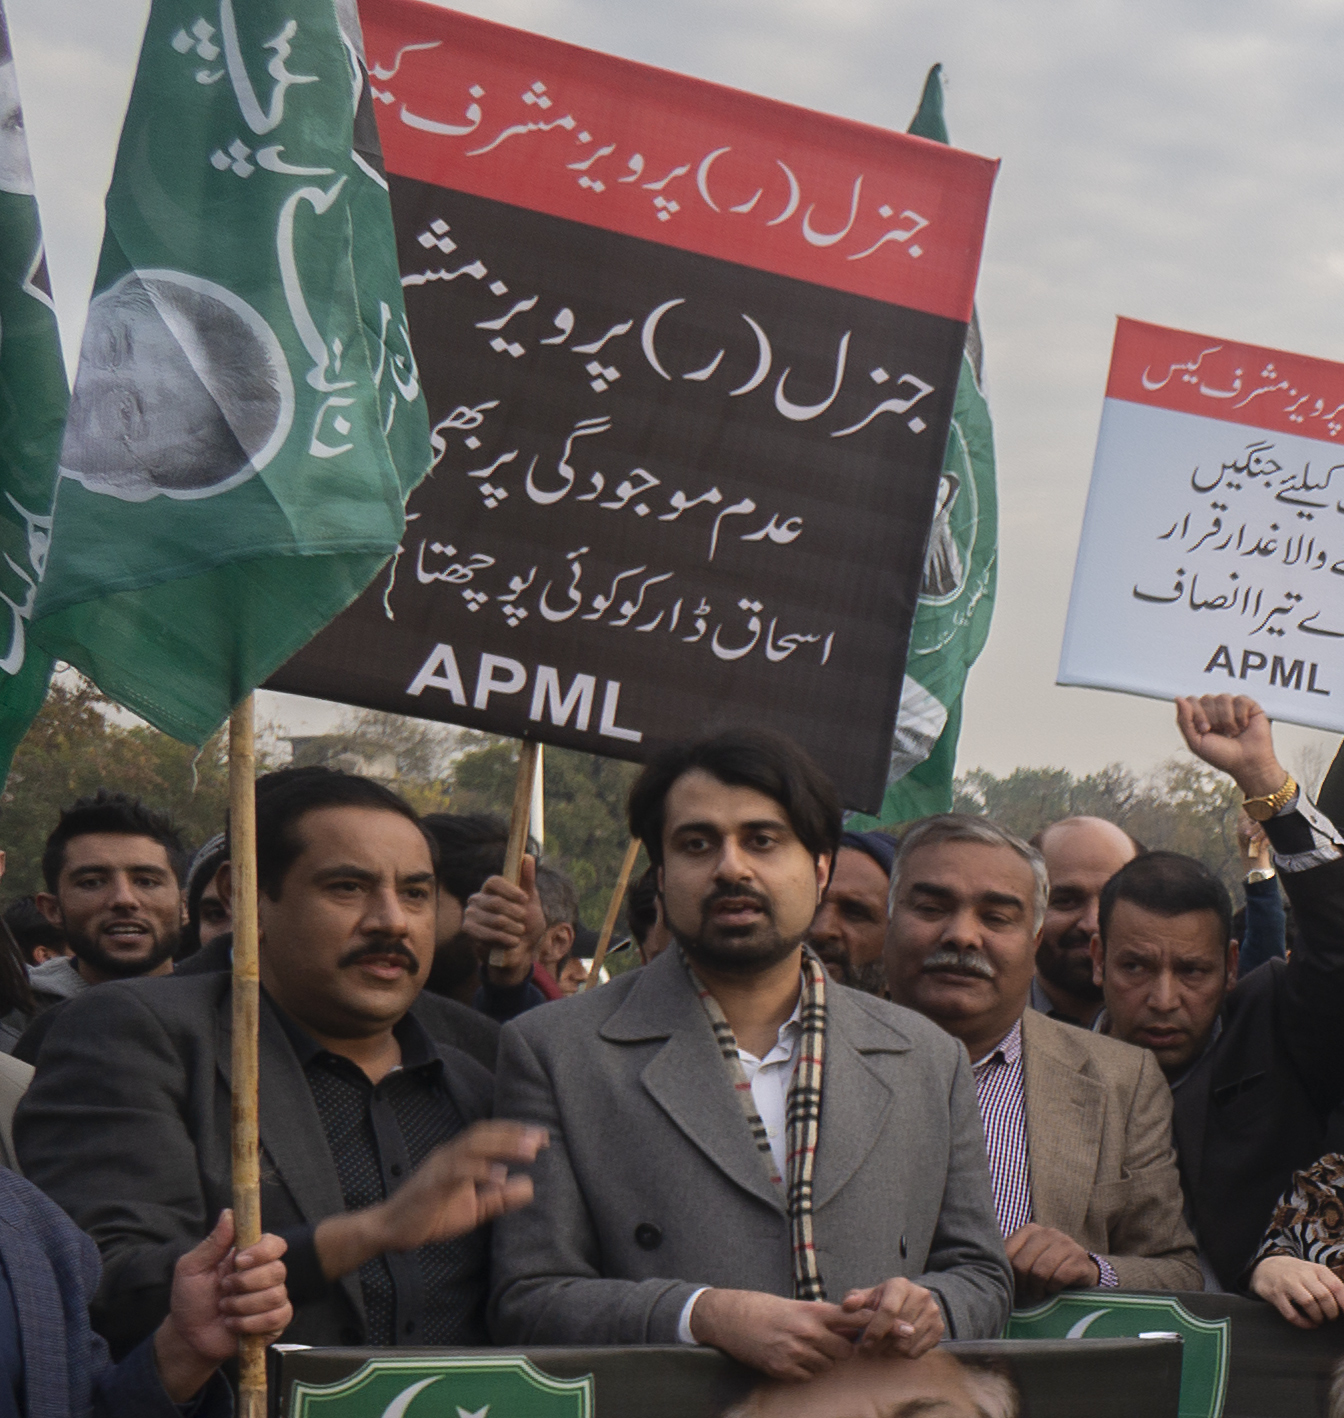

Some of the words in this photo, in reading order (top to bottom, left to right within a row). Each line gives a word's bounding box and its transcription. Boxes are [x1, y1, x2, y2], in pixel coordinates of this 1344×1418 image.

[367, 40, 443, 105] کی
[400, 80, 576, 157] مشرف
[567, 131, 691, 222] پرویز
[475, 278, 634, 393] پرویز
[1141, 345, 1224, 391] کیس
[1200, 362, 1290, 409] مشرف
[468, 449, 519, 509] پر
[525, 416, 723, 517] موجودگی
[708, 497, 804, 562] عدم
[1157, 501, 1229, 553] قرار
[1212, 522, 1279, 557] غدار
[1282, 533, 1328, 571] والا
[635, 596, 711, 643] ڈار
[1132, 567, 1252, 616] انصاف
[711, 597, 835, 665] اسحاق
[405, 643, 643, 743] APML
[1203, 643, 1332, 697] APML
